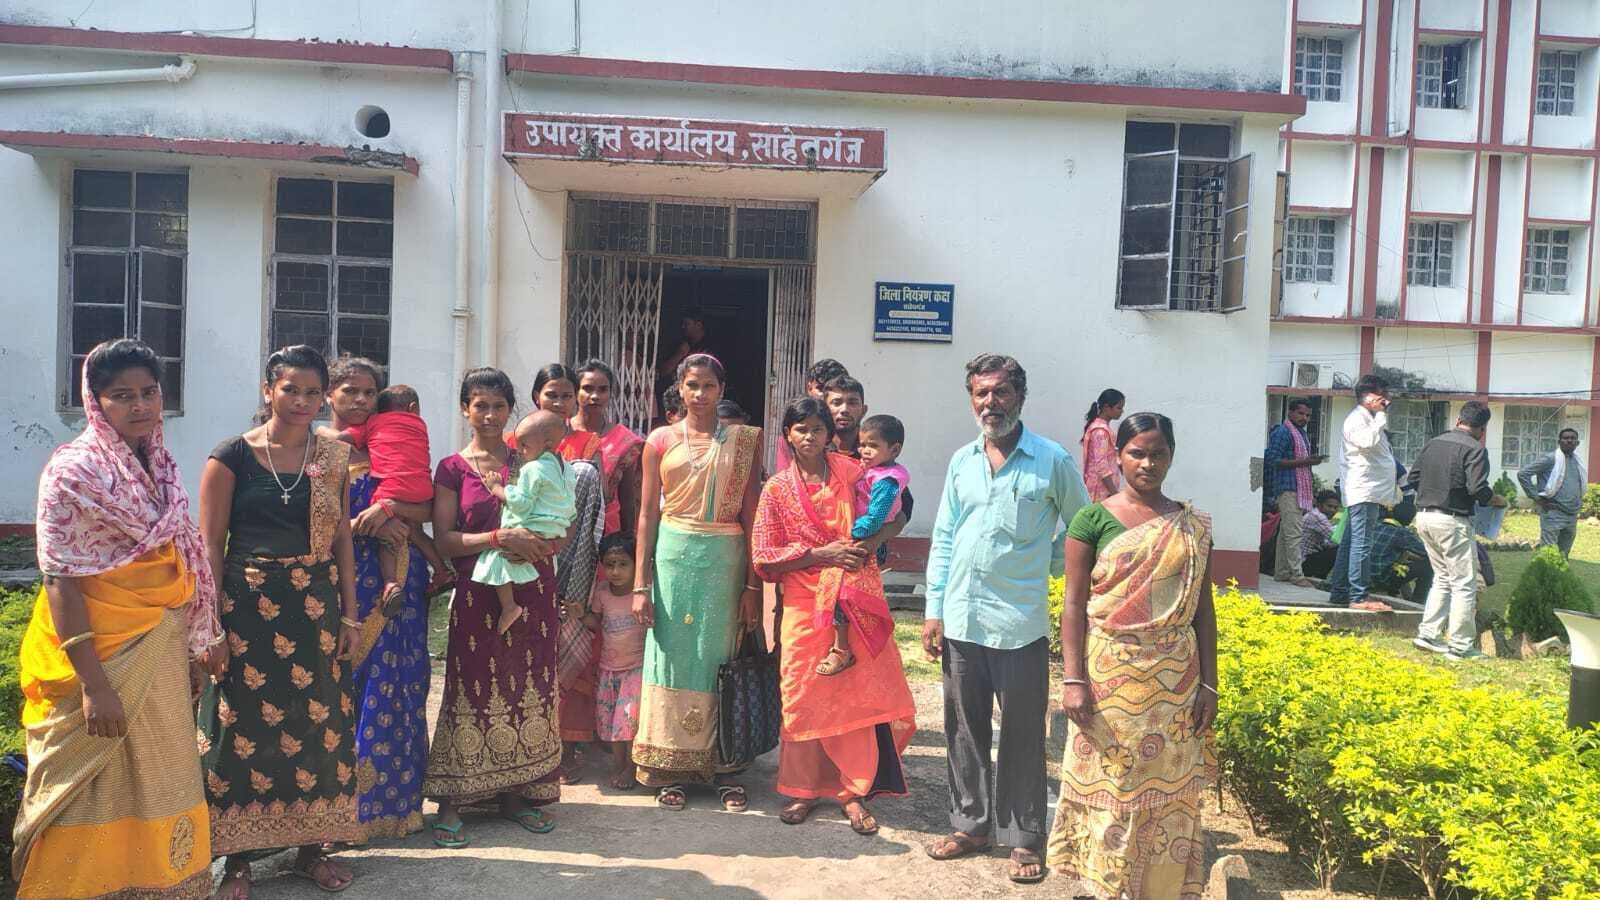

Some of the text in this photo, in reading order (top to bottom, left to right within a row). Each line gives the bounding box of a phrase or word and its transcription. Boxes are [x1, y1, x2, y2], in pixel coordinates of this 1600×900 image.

[749, 126, 864, 164] साहेबगंज
[879, 286, 900, 301] जिला
[903, 287, 931, 302] नियंत्रण
